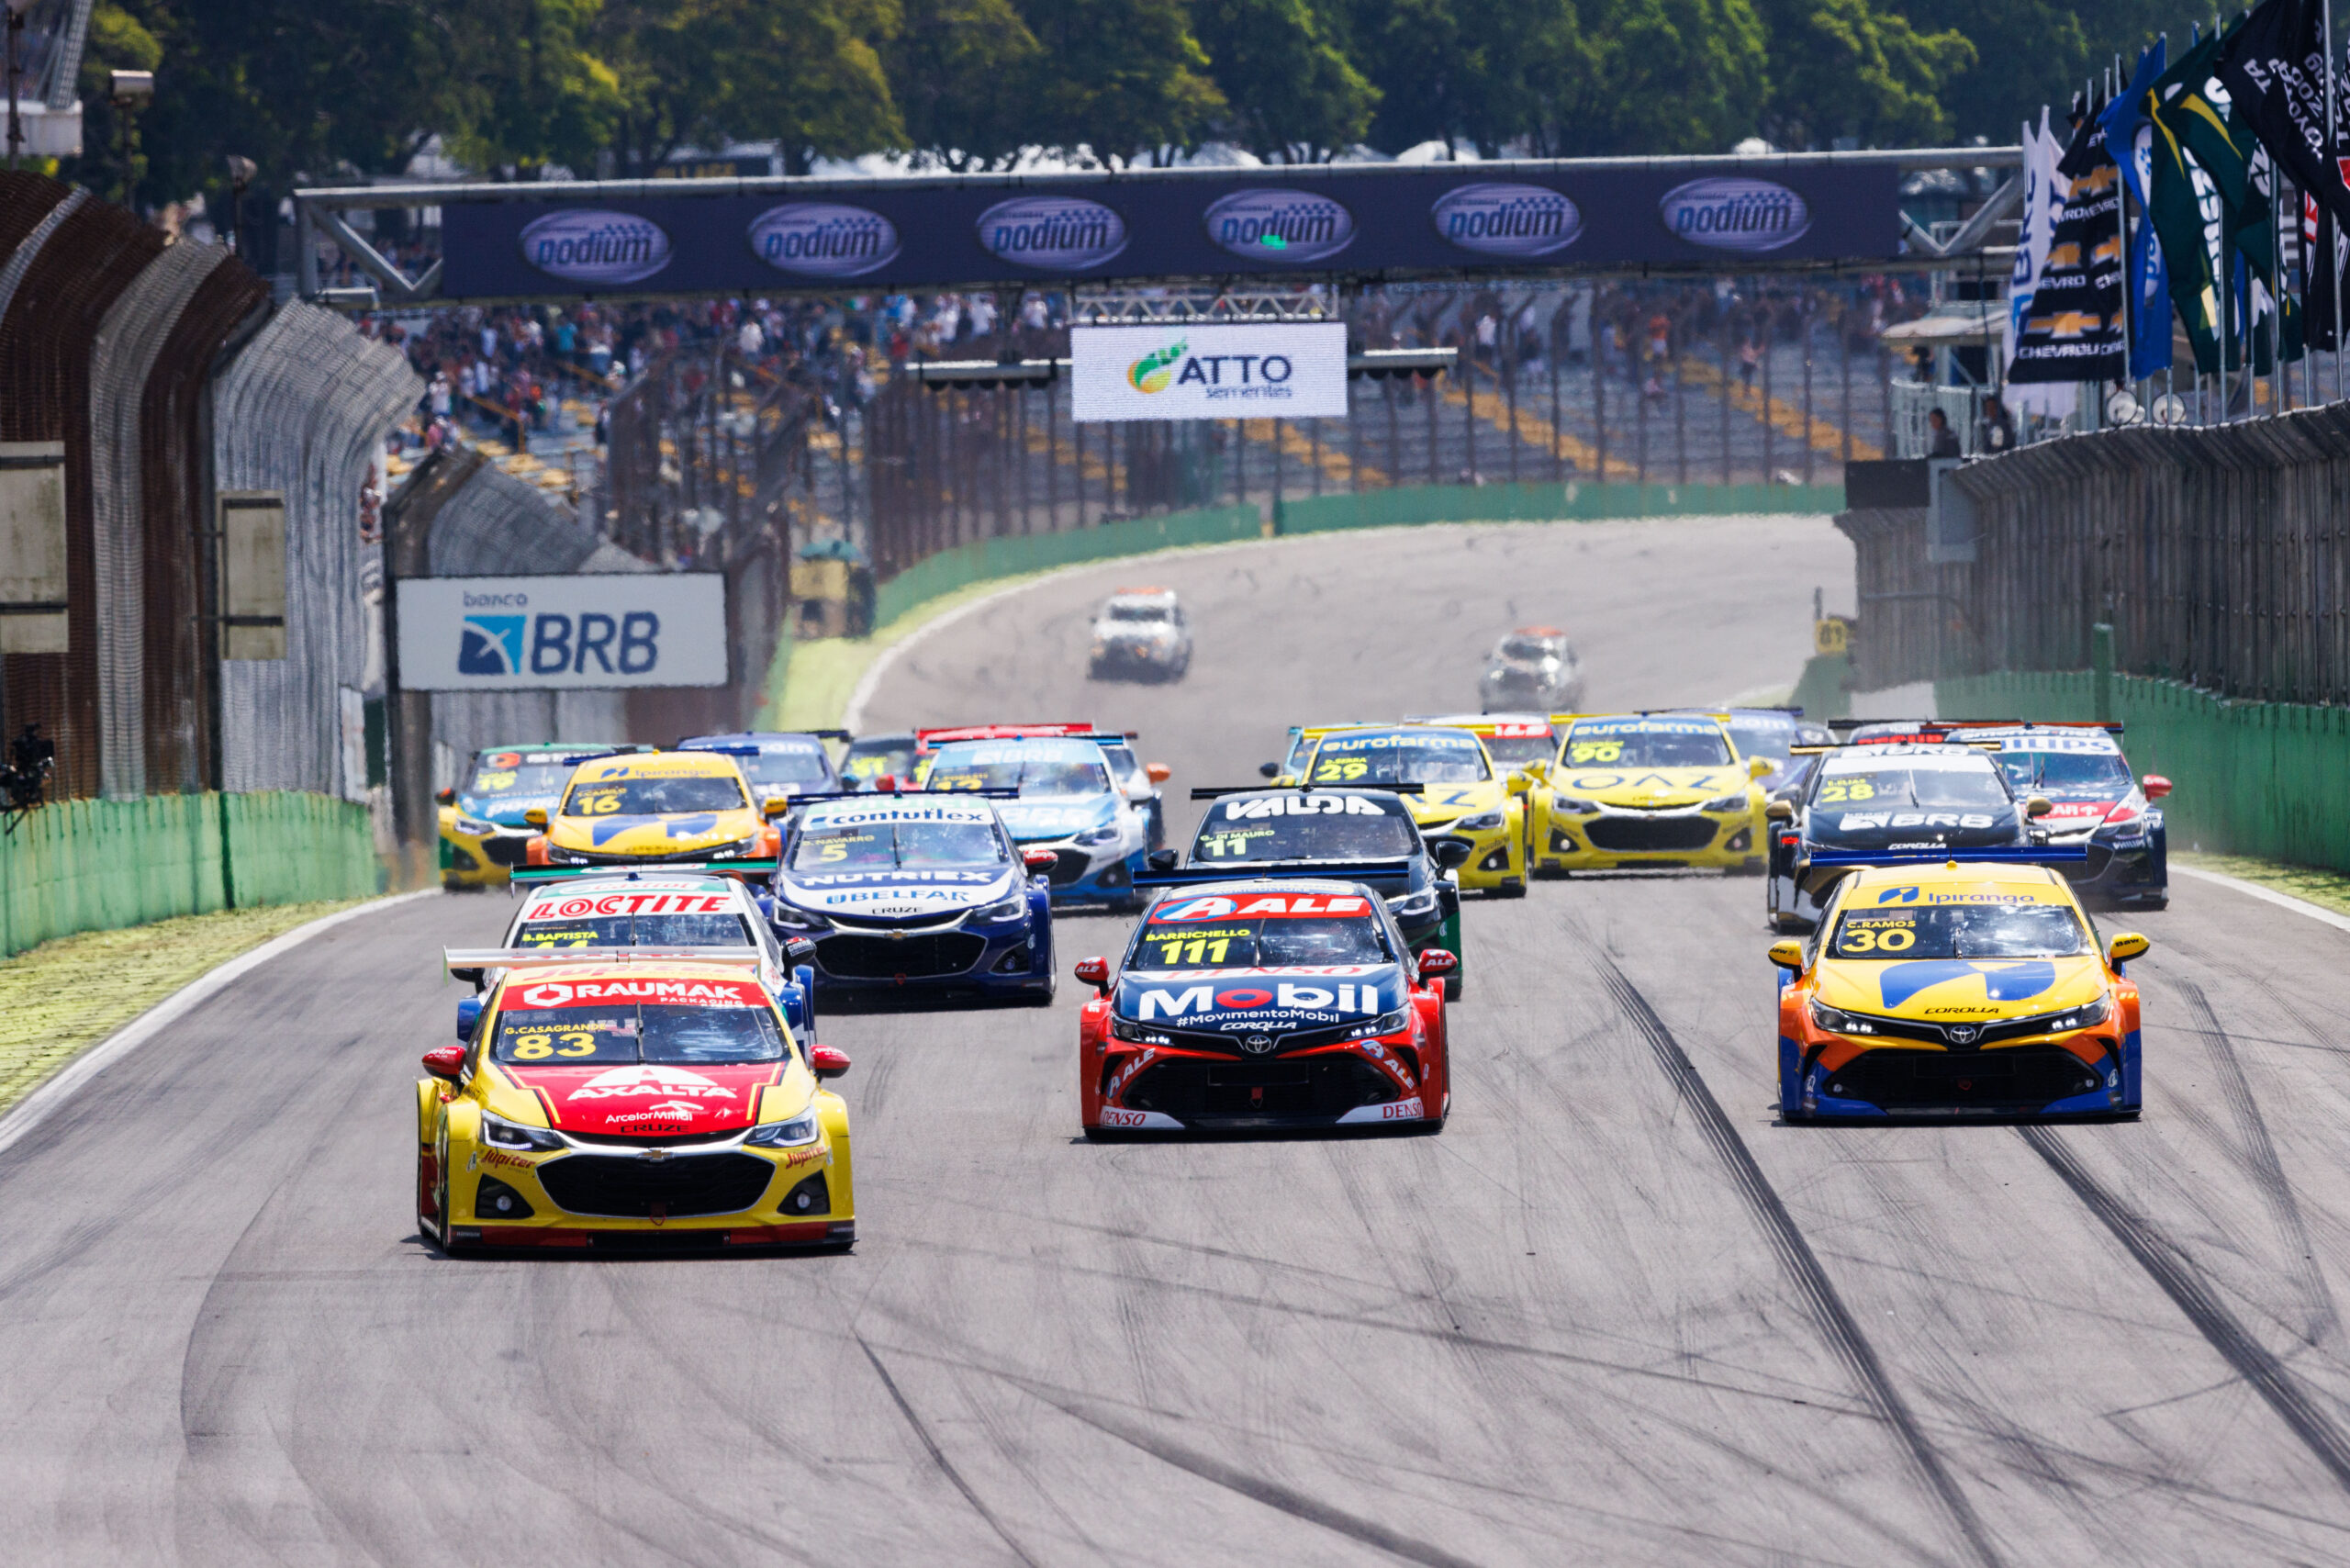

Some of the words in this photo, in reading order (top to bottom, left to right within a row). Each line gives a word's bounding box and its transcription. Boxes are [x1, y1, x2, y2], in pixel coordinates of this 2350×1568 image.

[1449, 203, 1564, 237] podium
[1677, 198, 1791, 232] podium
[993, 216, 1108, 252] podium
[1221, 209, 1336, 245] podium
[538, 230, 653, 264] podium
[765, 225, 881, 258] podium
[1178, 355, 1292, 385] ATTO
[464, 591, 527, 607] banco
[531, 611, 660, 675] BRB
[1573, 720, 1722, 736] eurofarma
[1322, 735, 1476, 752] eurofarma
[1572, 746, 1621, 763] 90
[1315, 763, 1368, 781] 29
[1821, 784, 1875, 802] 28
[578, 796, 621, 814] 16
[1226, 796, 1385, 820] VALDA
[834, 809, 984, 824] contuflex
[1891, 813, 1993, 828] BRB
[819, 844, 848, 862] 5
[1205, 838, 1246, 857] 11
[1888, 842, 1947, 850] COROLLA
[800, 871, 992, 887] NUTRIEX
[528, 895, 731, 919] LOCTITE
[1237, 898, 1366, 913] ALE
[1929, 892, 2035, 904] Ipiranga
[872, 906, 923, 915] CRUZE
[1847, 920, 1916, 929] C.RAMOS
[522, 931, 599, 942] B.BAPTISTA
[1146, 929, 1250, 942] BARRICHELLO
[1841, 929, 1916, 952] 30
[1160, 938, 1230, 964] 111
[1426, 958, 1453, 967] ALE
[1163, 966, 1361, 980] DENSO
[577, 982, 744, 1000] RAUMAK
[1139, 983, 1378, 1021] Mobil
[1176, 1009, 1339, 1027] #MovimentoMobil
[1220, 1021, 1298, 1032] COROLLA
[506, 1024, 606, 1035] G.CASAGRANDE
[514, 1033, 596, 1059] 83
[1123, 1047, 1157, 1082] ALE
[1383, 1058, 1415, 1090] ALE
[567, 1085, 737, 1101] AXALTA
[1103, 1110, 1147, 1126] DENSO
[1382, 1102, 1423, 1119] DENSO
[621, 1124, 690, 1134] CRUZE
[481, 1148, 536, 1169] Jupiter
